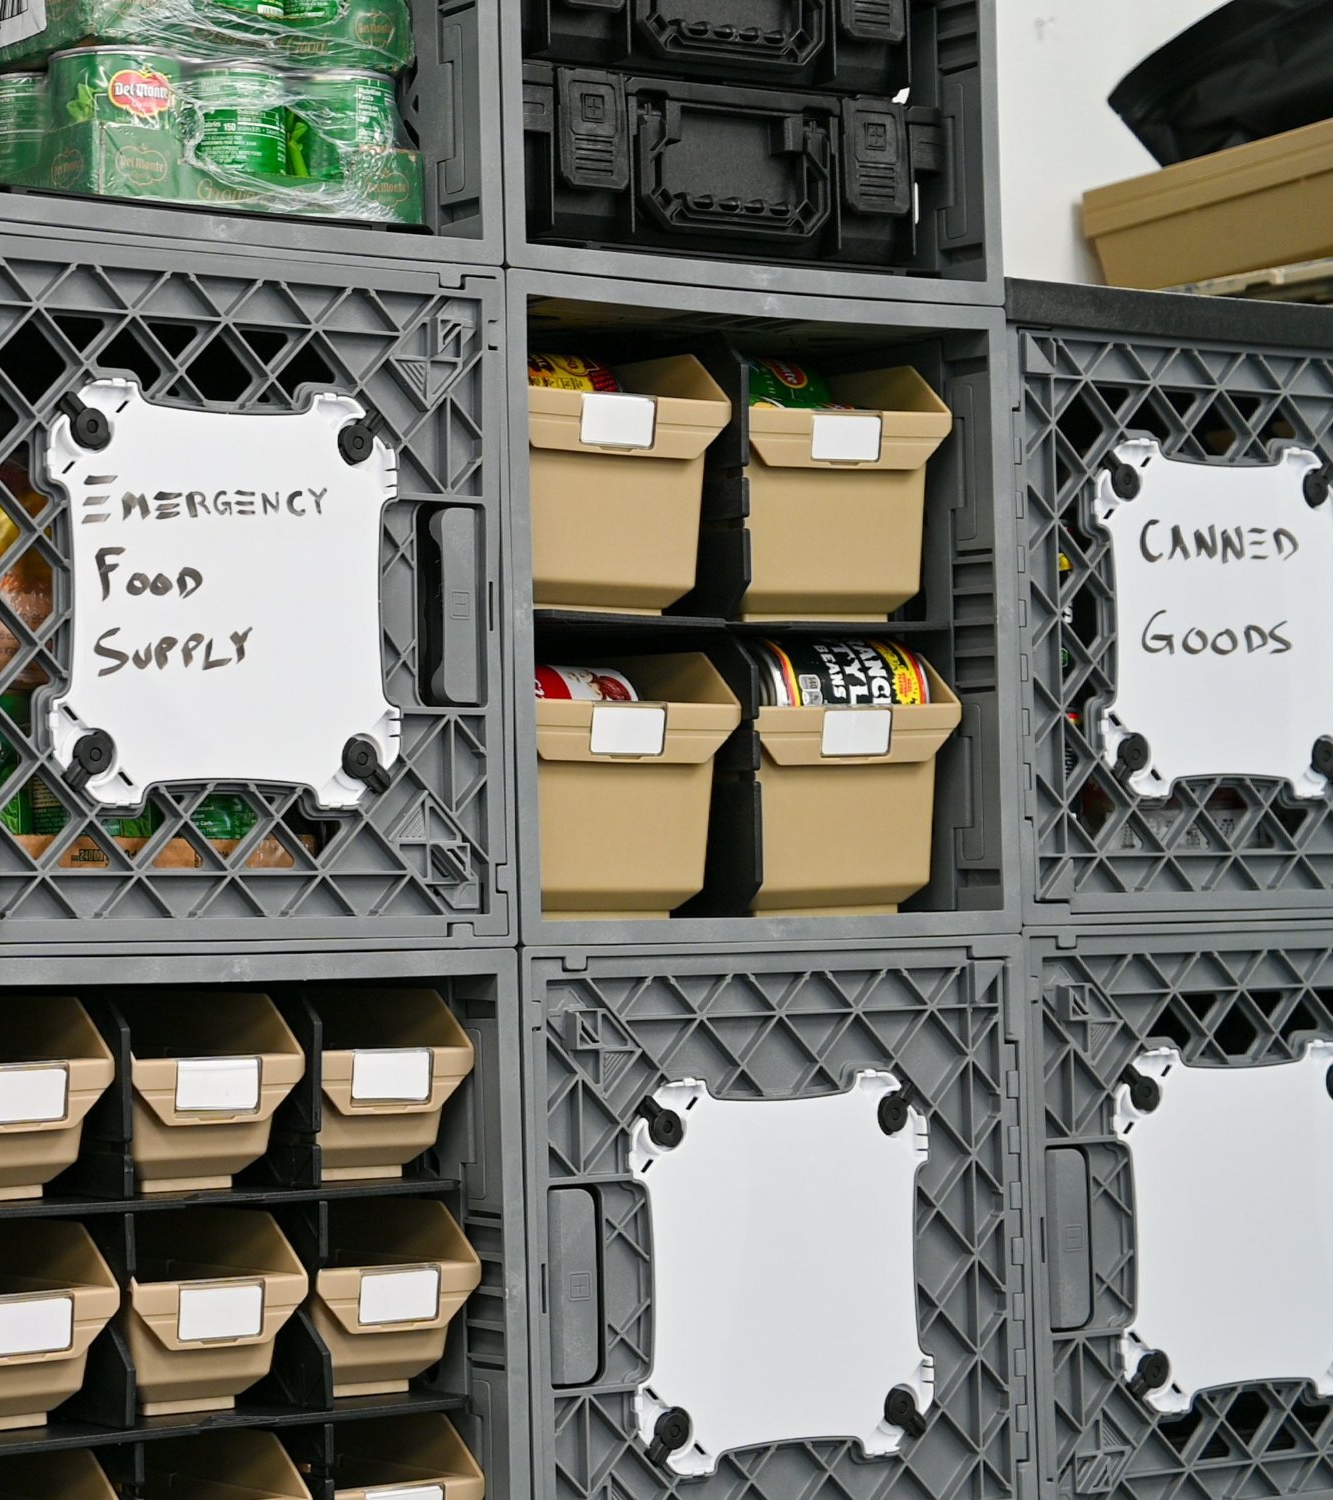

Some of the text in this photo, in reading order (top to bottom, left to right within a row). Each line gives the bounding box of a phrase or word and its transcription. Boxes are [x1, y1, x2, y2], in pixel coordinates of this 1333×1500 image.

[114, 82, 169, 99] Del Monte
[81, 474, 328, 525] EMERGENCY
[1139, 518, 1300, 565] CANNED
[94, 546, 204, 602] FOOD
[93, 626, 254, 678] SUPPLY
[1141, 609, 1292, 656] GOODS
[813, 644, 847, 699] BEANS
